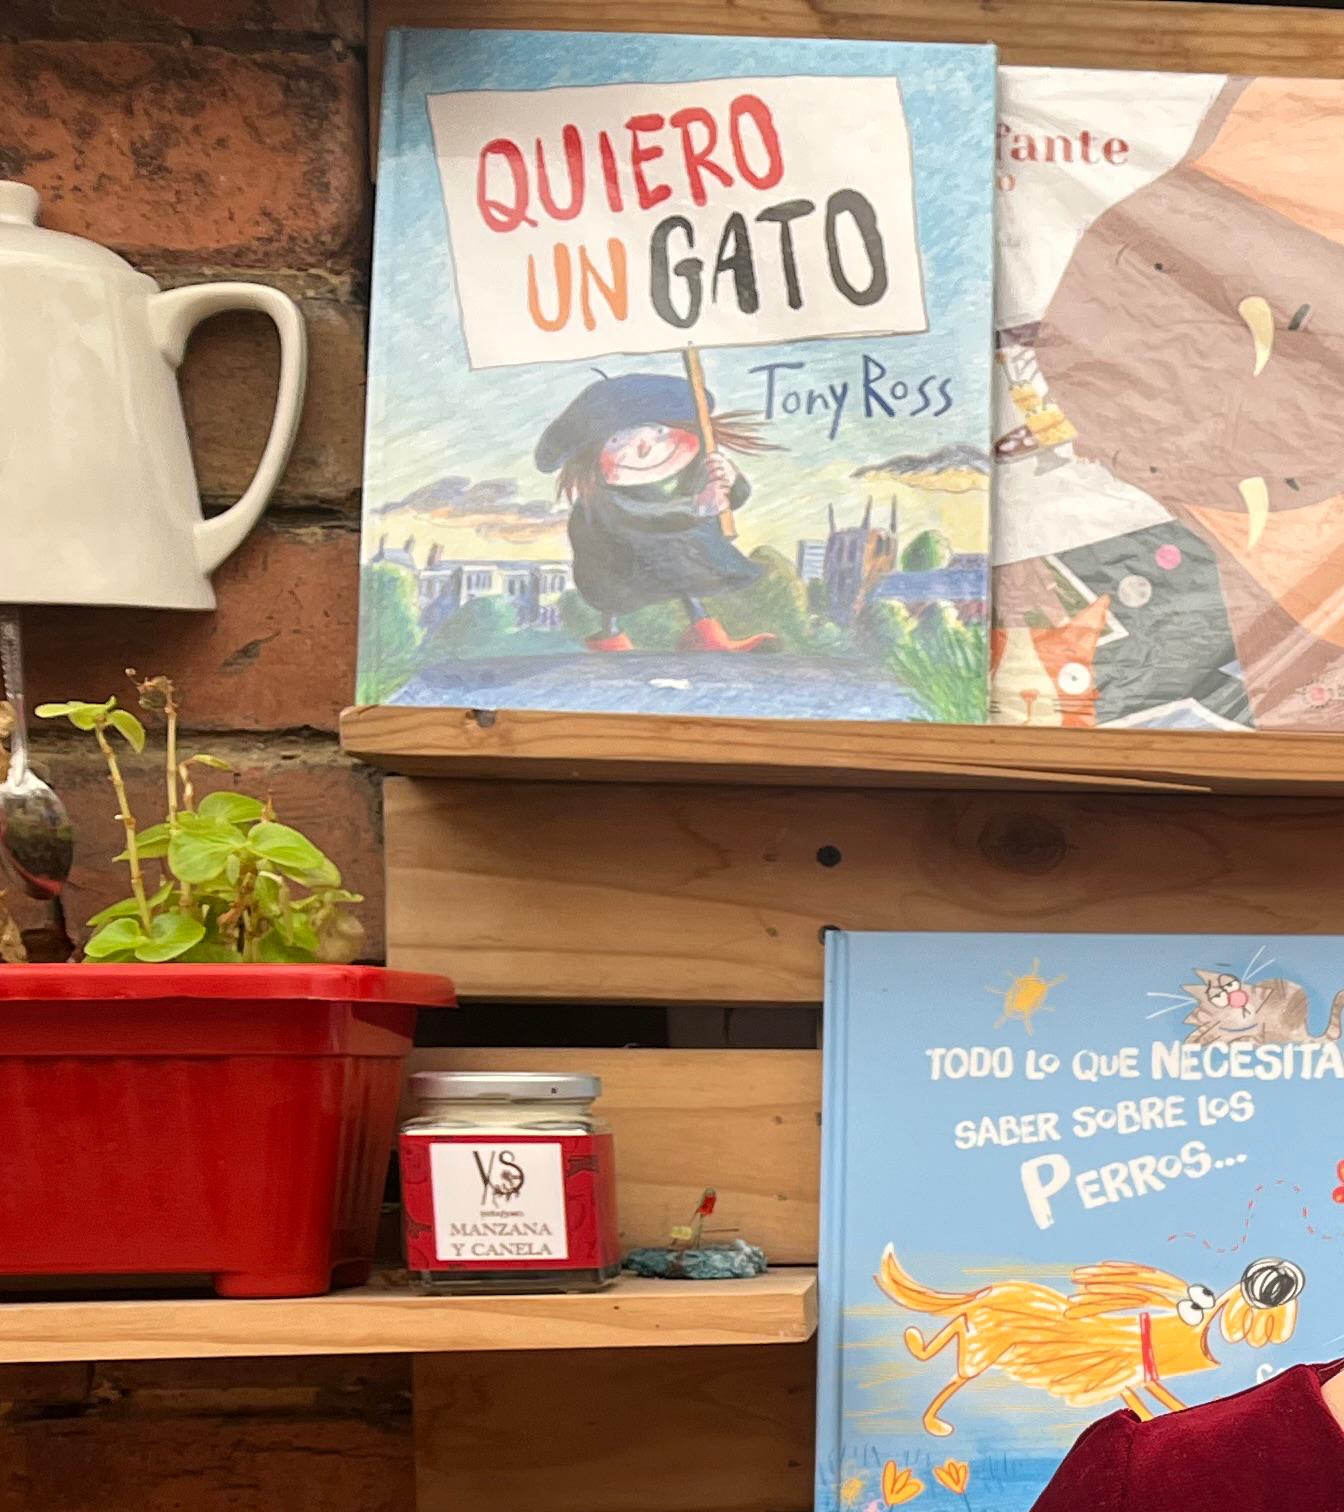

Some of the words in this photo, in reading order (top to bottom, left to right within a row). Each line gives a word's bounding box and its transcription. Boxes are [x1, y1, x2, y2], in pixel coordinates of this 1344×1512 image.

[477, 95, 784, 233] QUIERO
[528, 237, 628, 331] UN
[650, 188, 888, 330] GATO
[749, 362, 849, 438] Tony
[862, 355, 953, 417] Ross
[926, 1046, 1014, 1081] TODO
[1072, 1046, 1139, 1083] QUE
[954, 1110, 1062, 1152] SABER
[1073, 1095, 1187, 1139] SOBRE
[1197, 1091, 1256, 1127] LOS
[450, 1222, 553, 1237] MANZANA
[452, 1243, 465, 1256] Y
[471, 1242, 553, 1257] CANELA
